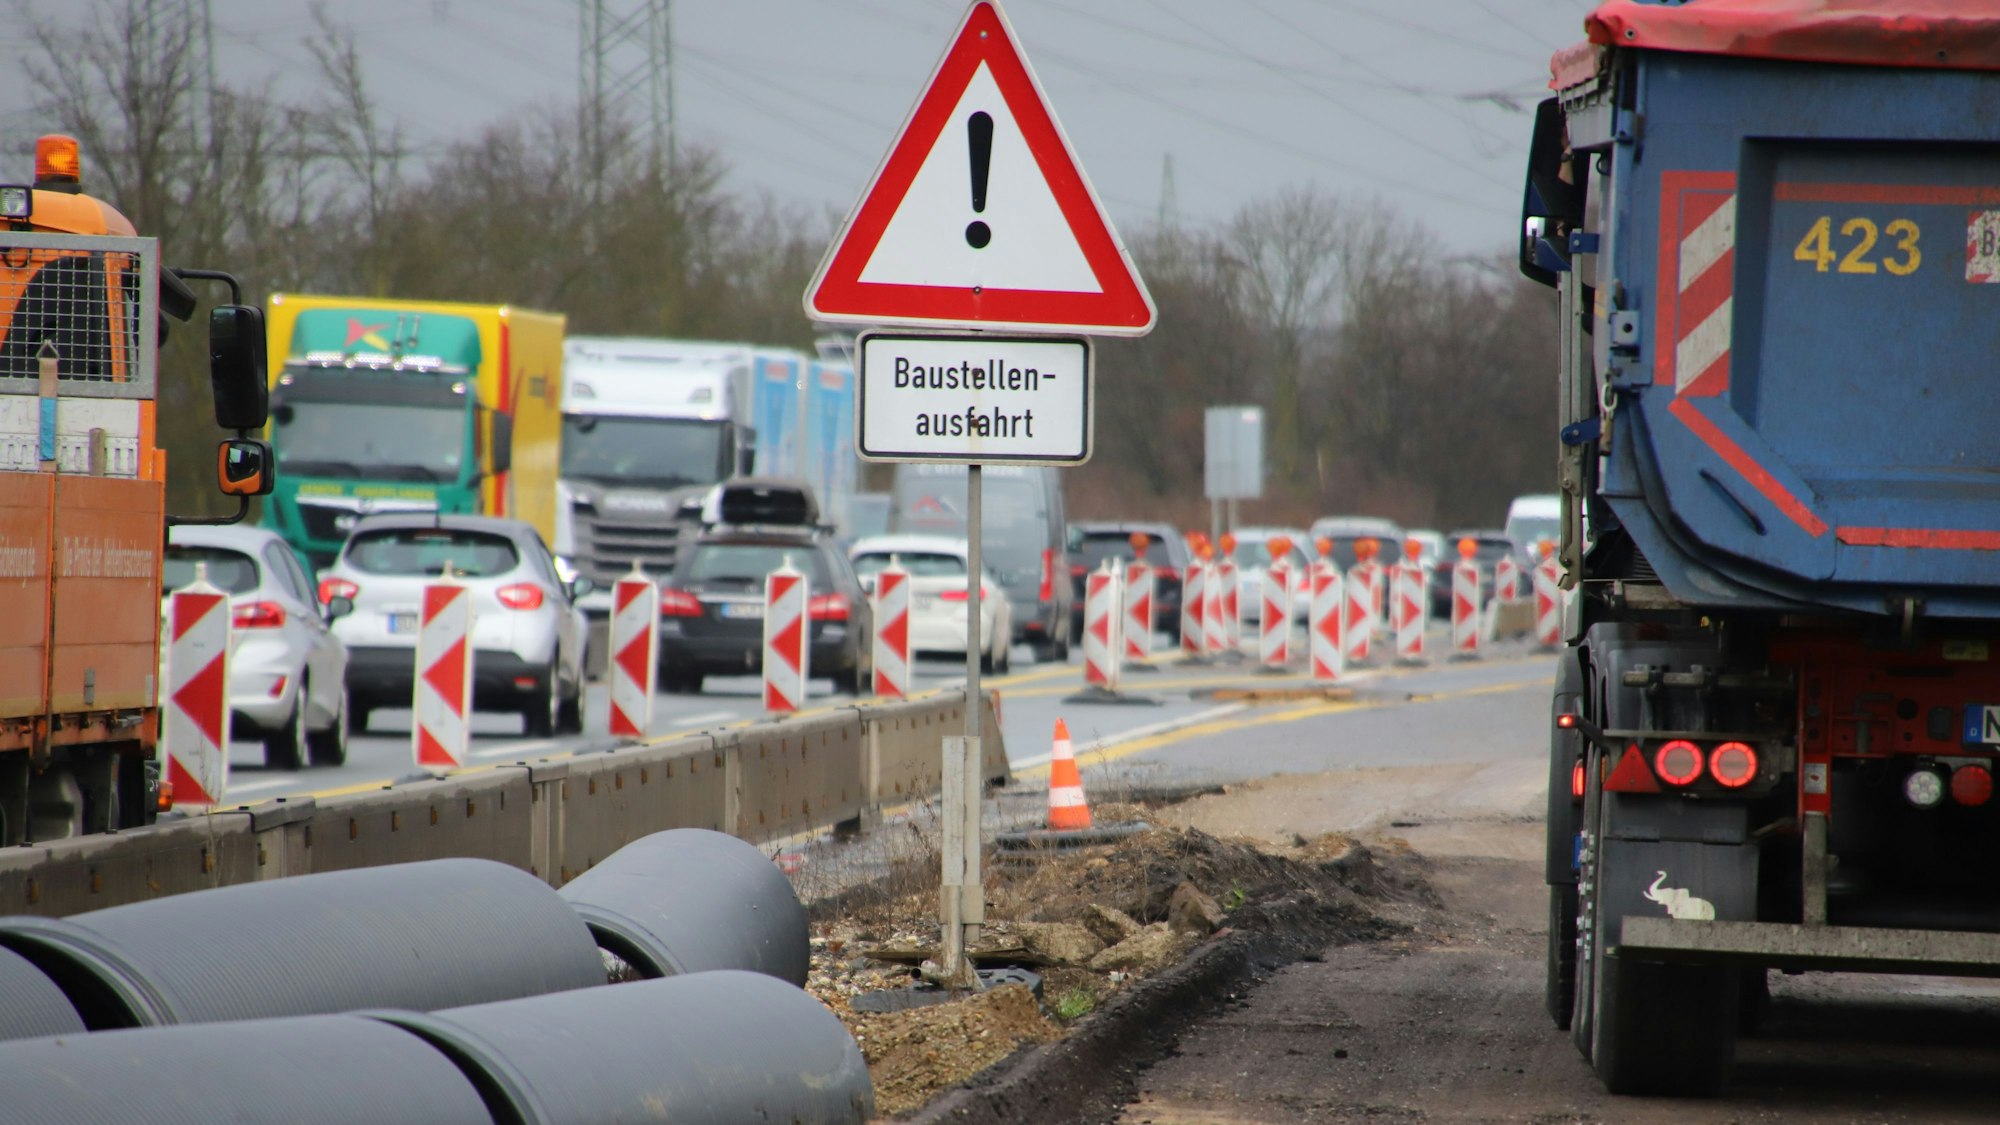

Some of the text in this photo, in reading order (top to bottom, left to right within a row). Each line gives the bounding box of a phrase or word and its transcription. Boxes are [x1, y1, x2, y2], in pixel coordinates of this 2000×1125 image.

[1794, 216, 1921, 276] 423
[894, 356, 1057, 392] Baustellen-
[915, 405, 1034, 438] ausfahrt
[0, 535, 36, 588] icherung.de
[1970, 727, 1979, 737] D
